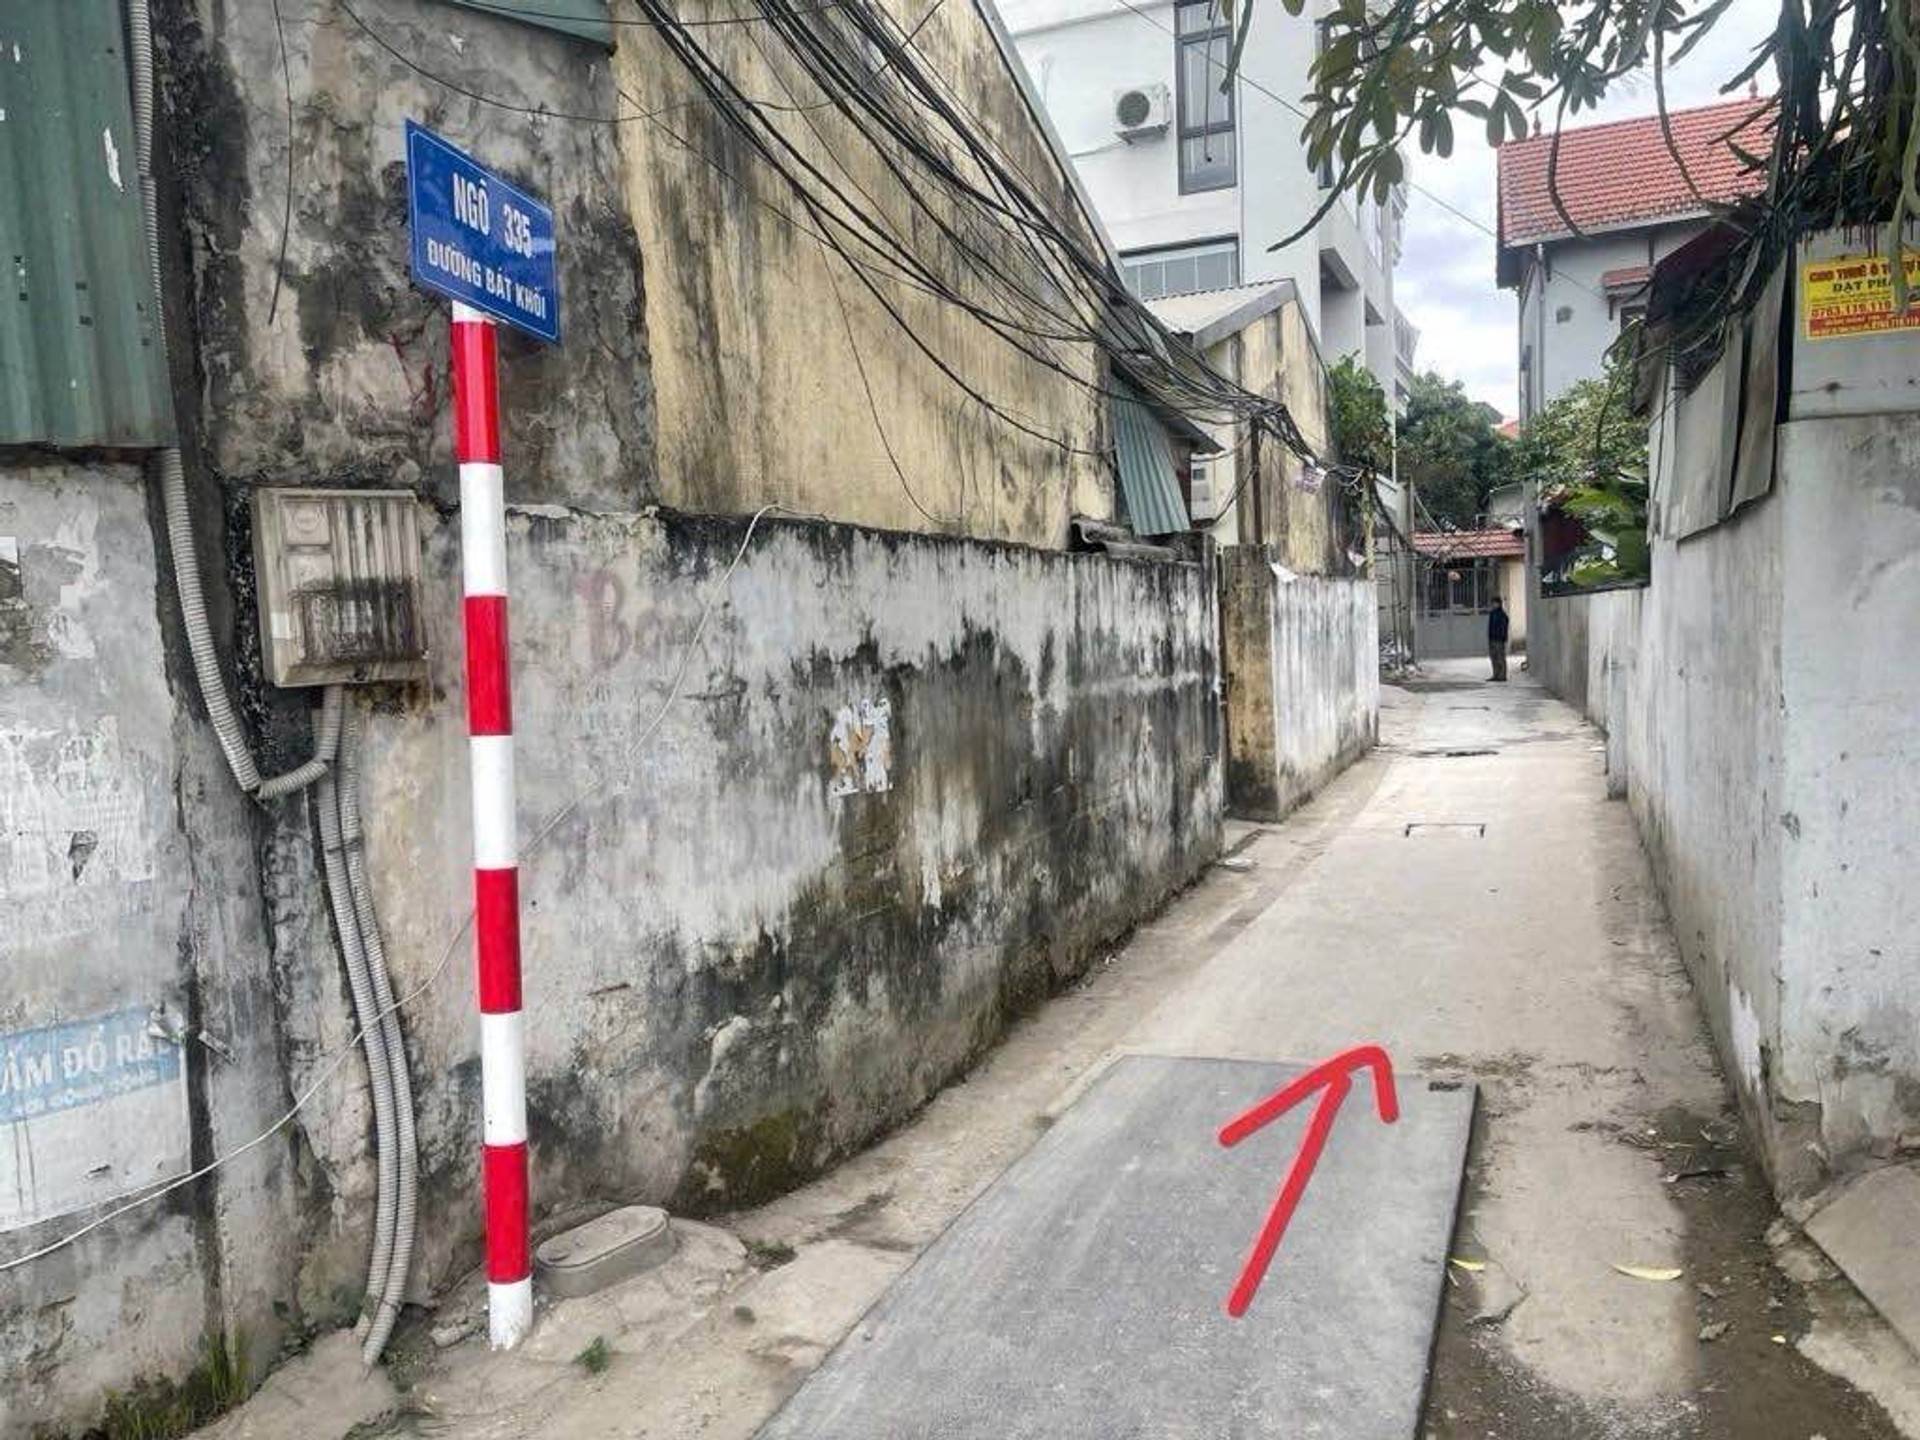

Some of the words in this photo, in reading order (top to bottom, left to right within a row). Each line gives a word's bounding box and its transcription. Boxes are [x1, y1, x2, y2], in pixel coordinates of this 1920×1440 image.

[453, 172, 489, 236] NGÕ
[503, 203, 532, 259] 335
[427, 237, 482, 289] ĐƯỜNG
[486, 267, 512, 303] BÁT
